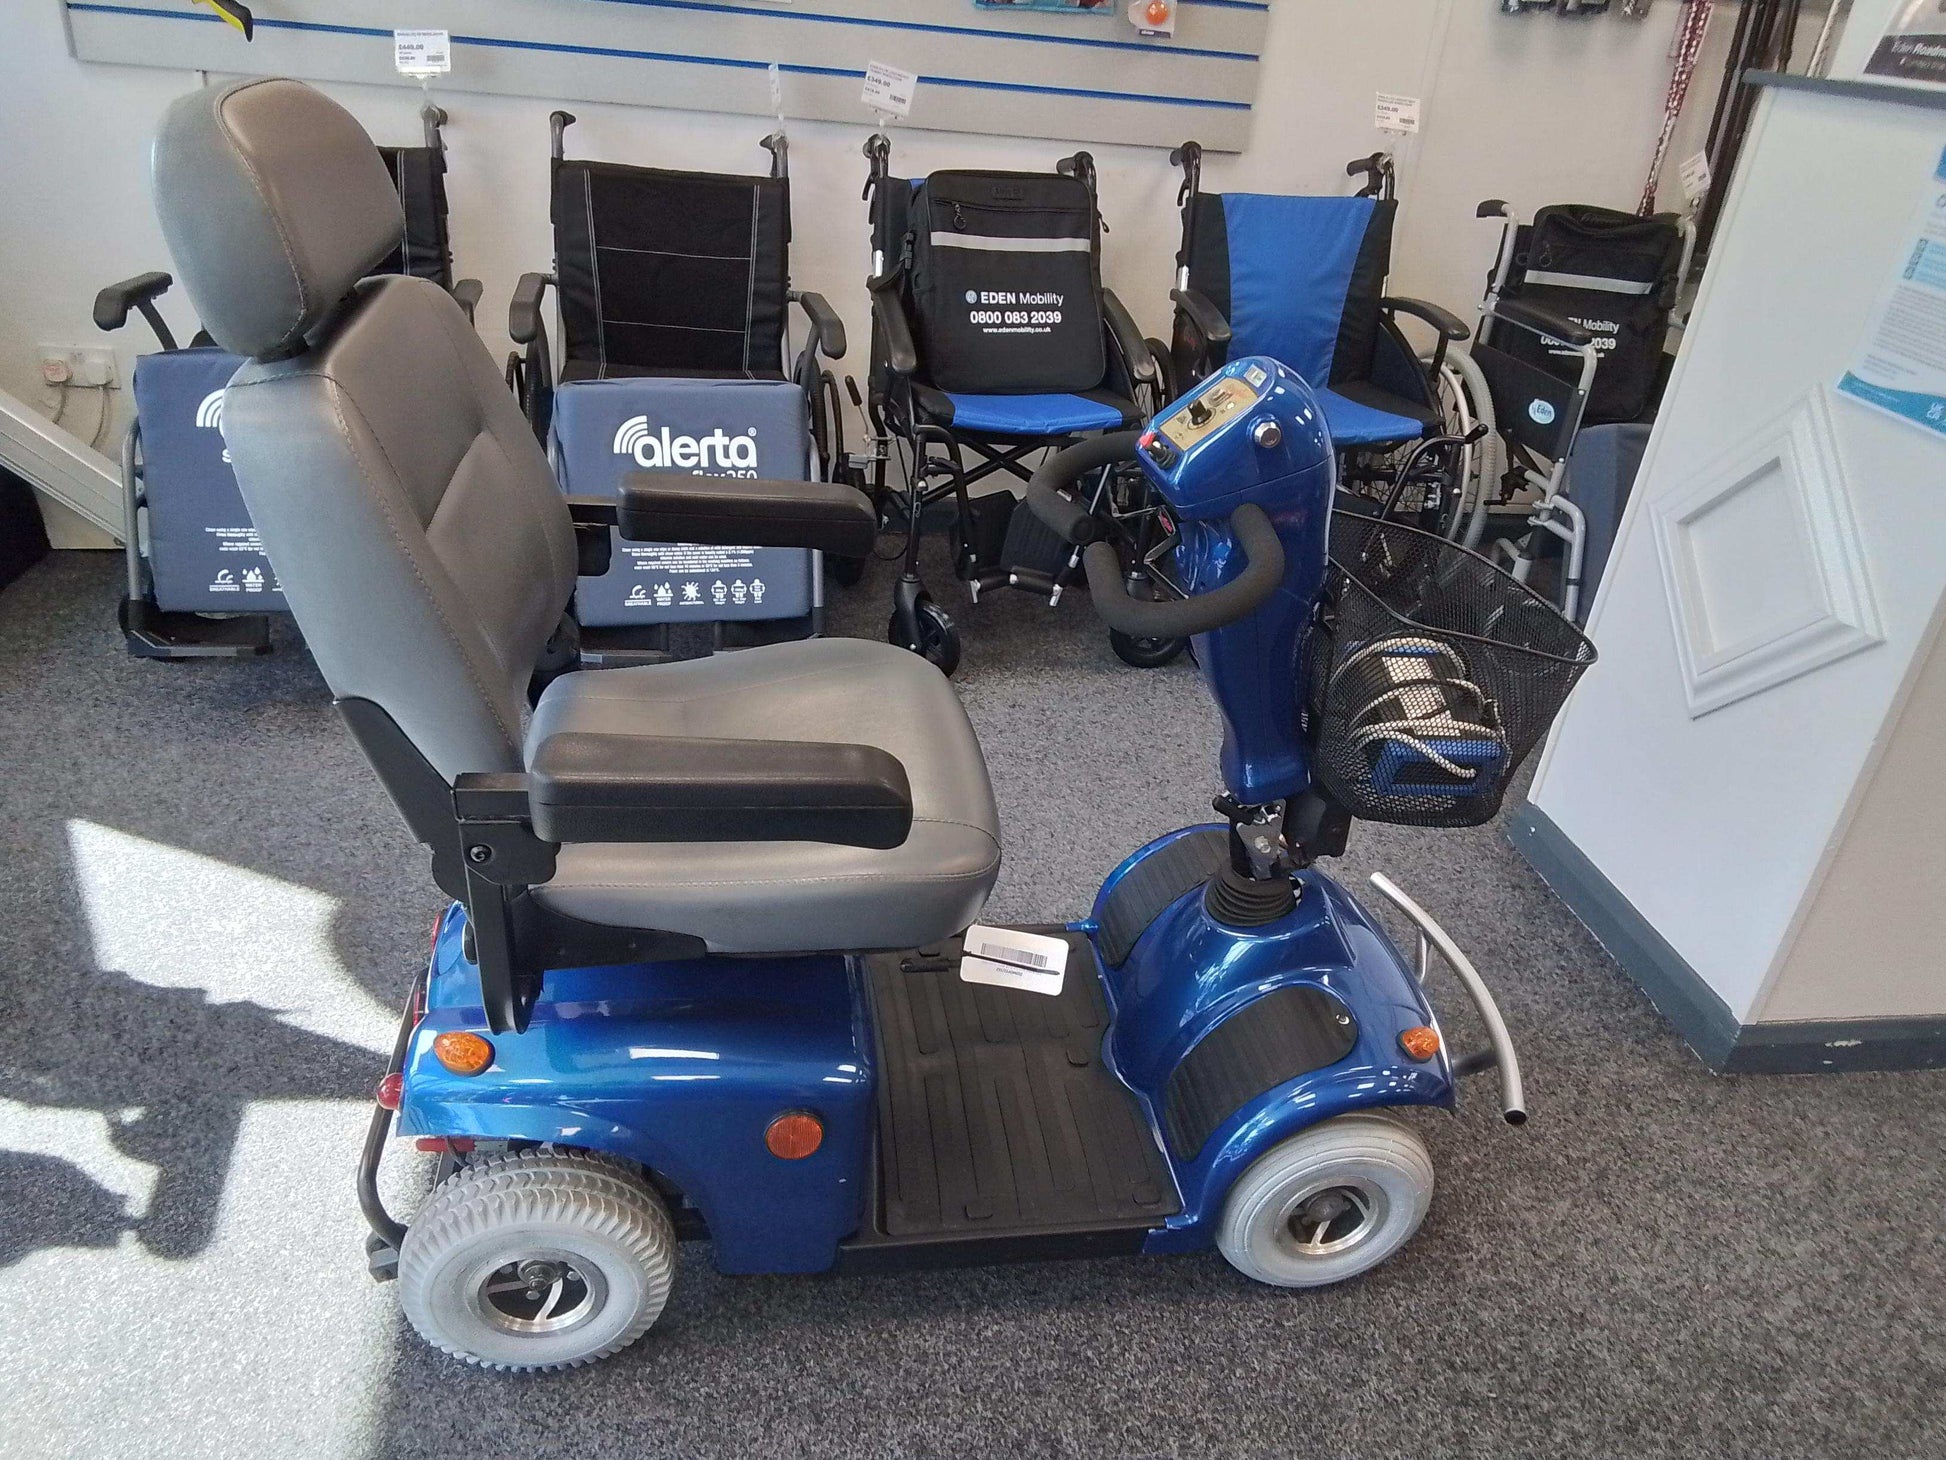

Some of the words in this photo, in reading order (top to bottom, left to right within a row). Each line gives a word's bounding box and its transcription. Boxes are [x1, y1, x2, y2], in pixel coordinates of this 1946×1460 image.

[980, 291, 1016, 305] EDEN
[1019, 292, 1064, 307] Mobility
[970, 310, 1001, 324] 0800
[1004, 310, 1028, 324] 083
[1030, 310, 1062, 324] 2039
[1582, 318, 1619, 334] Mobility
[633, 426, 757, 468] alerta
